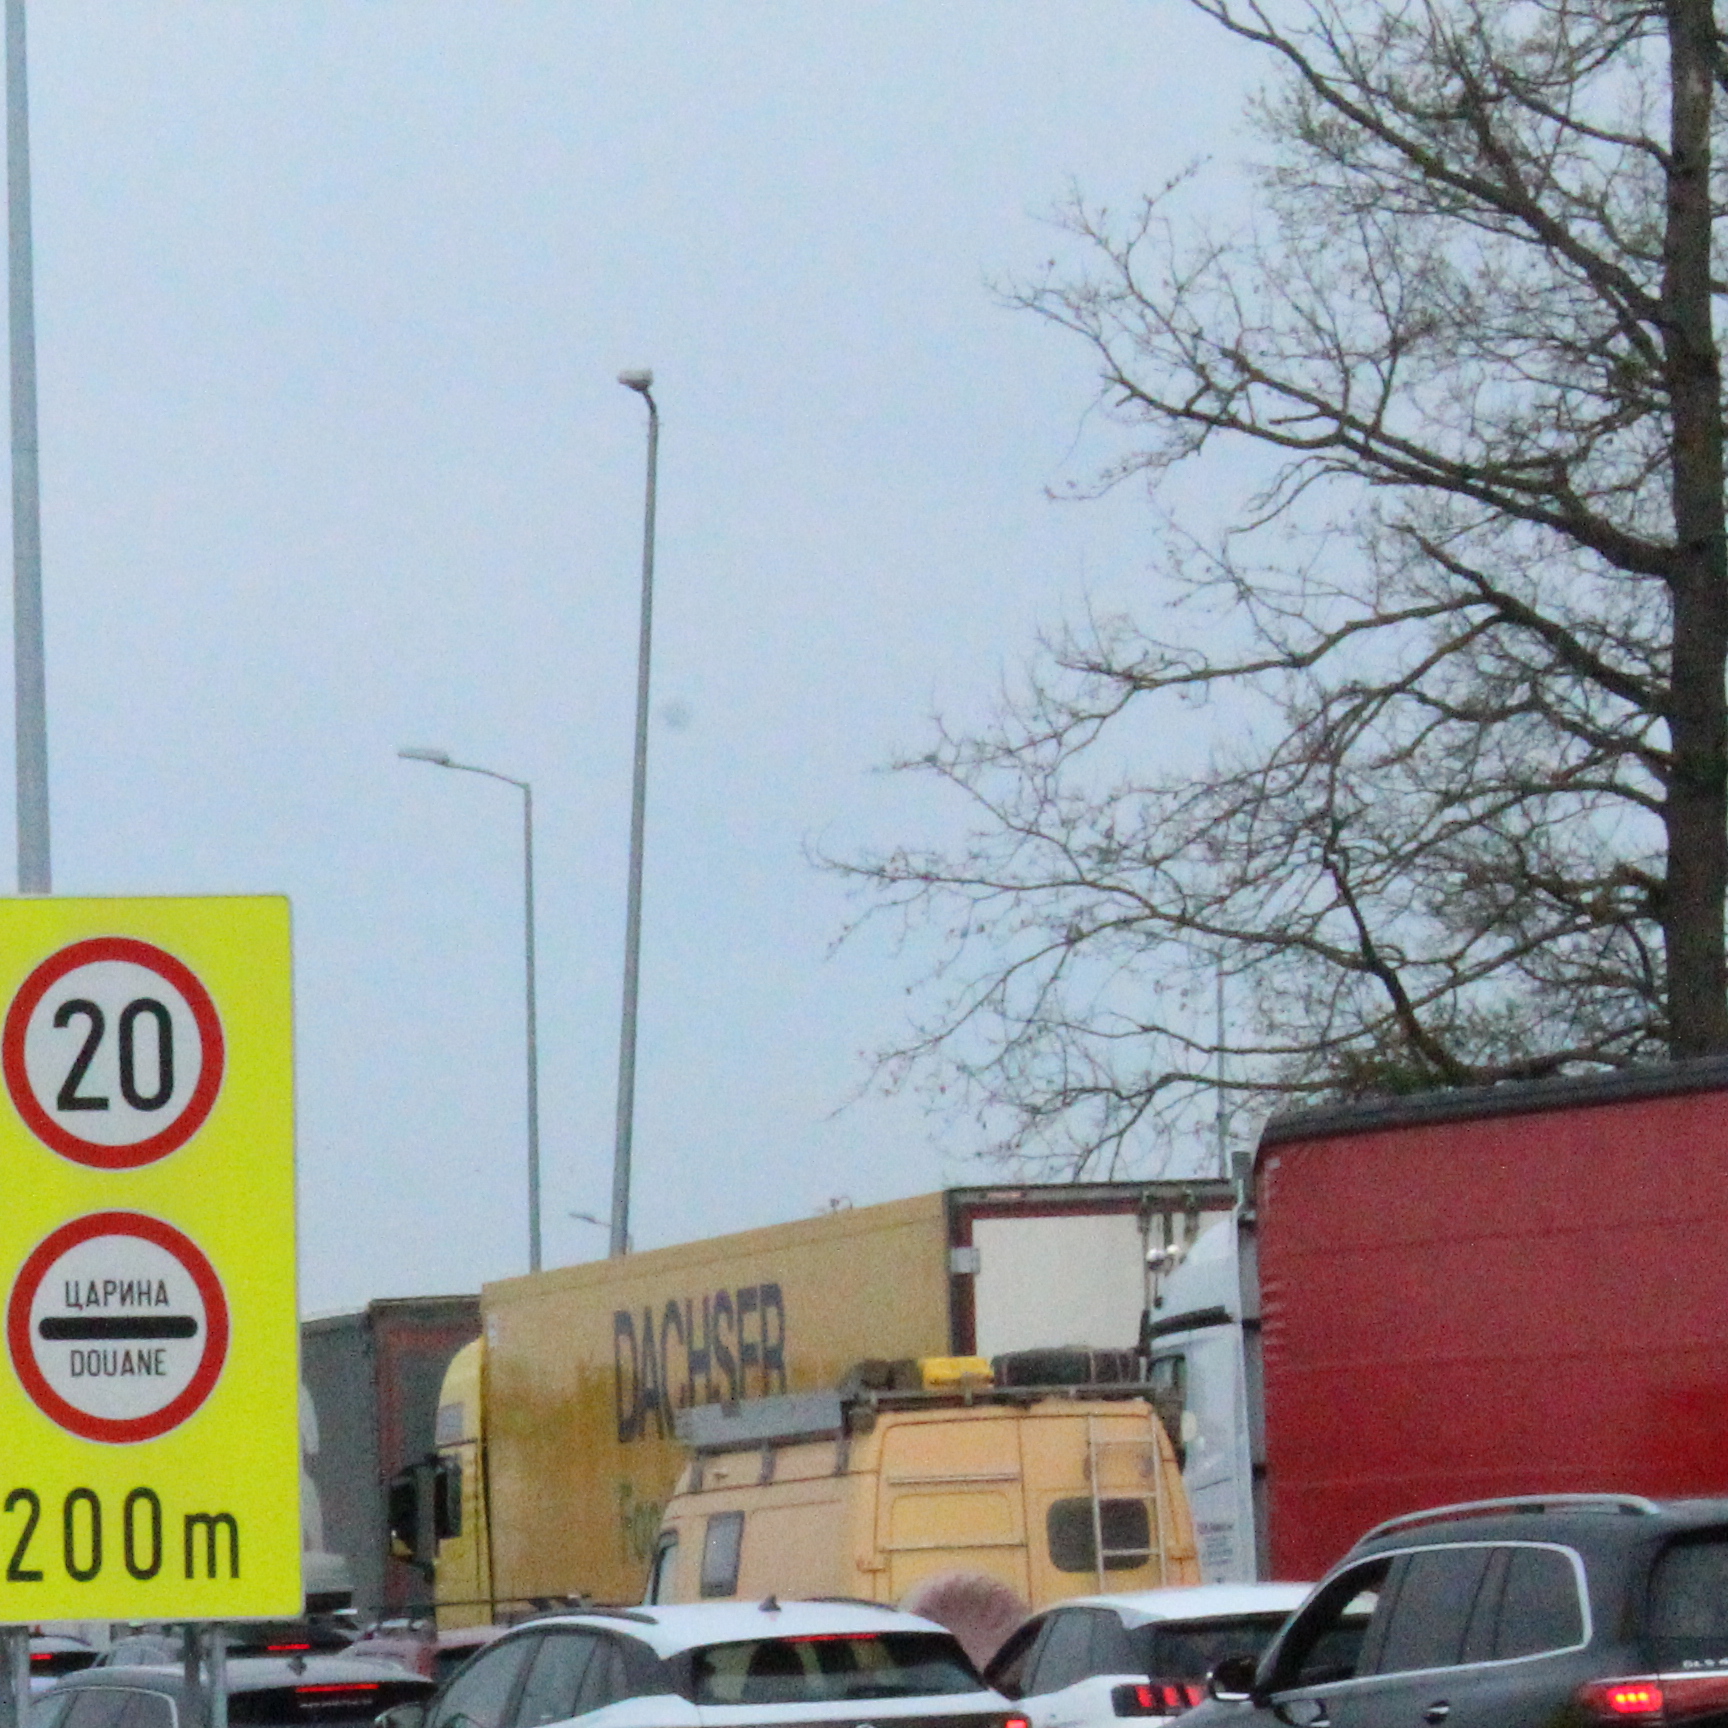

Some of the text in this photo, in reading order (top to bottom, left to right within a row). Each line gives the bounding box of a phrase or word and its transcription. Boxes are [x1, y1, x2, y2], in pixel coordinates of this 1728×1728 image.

[53, 997, 174, 1112] 20
[64, 1279, 171, 1311] ЦАРИНА
[70, 1348, 168, 1377] DOUANE
[612, 1282, 787, 1443] DACHSER
